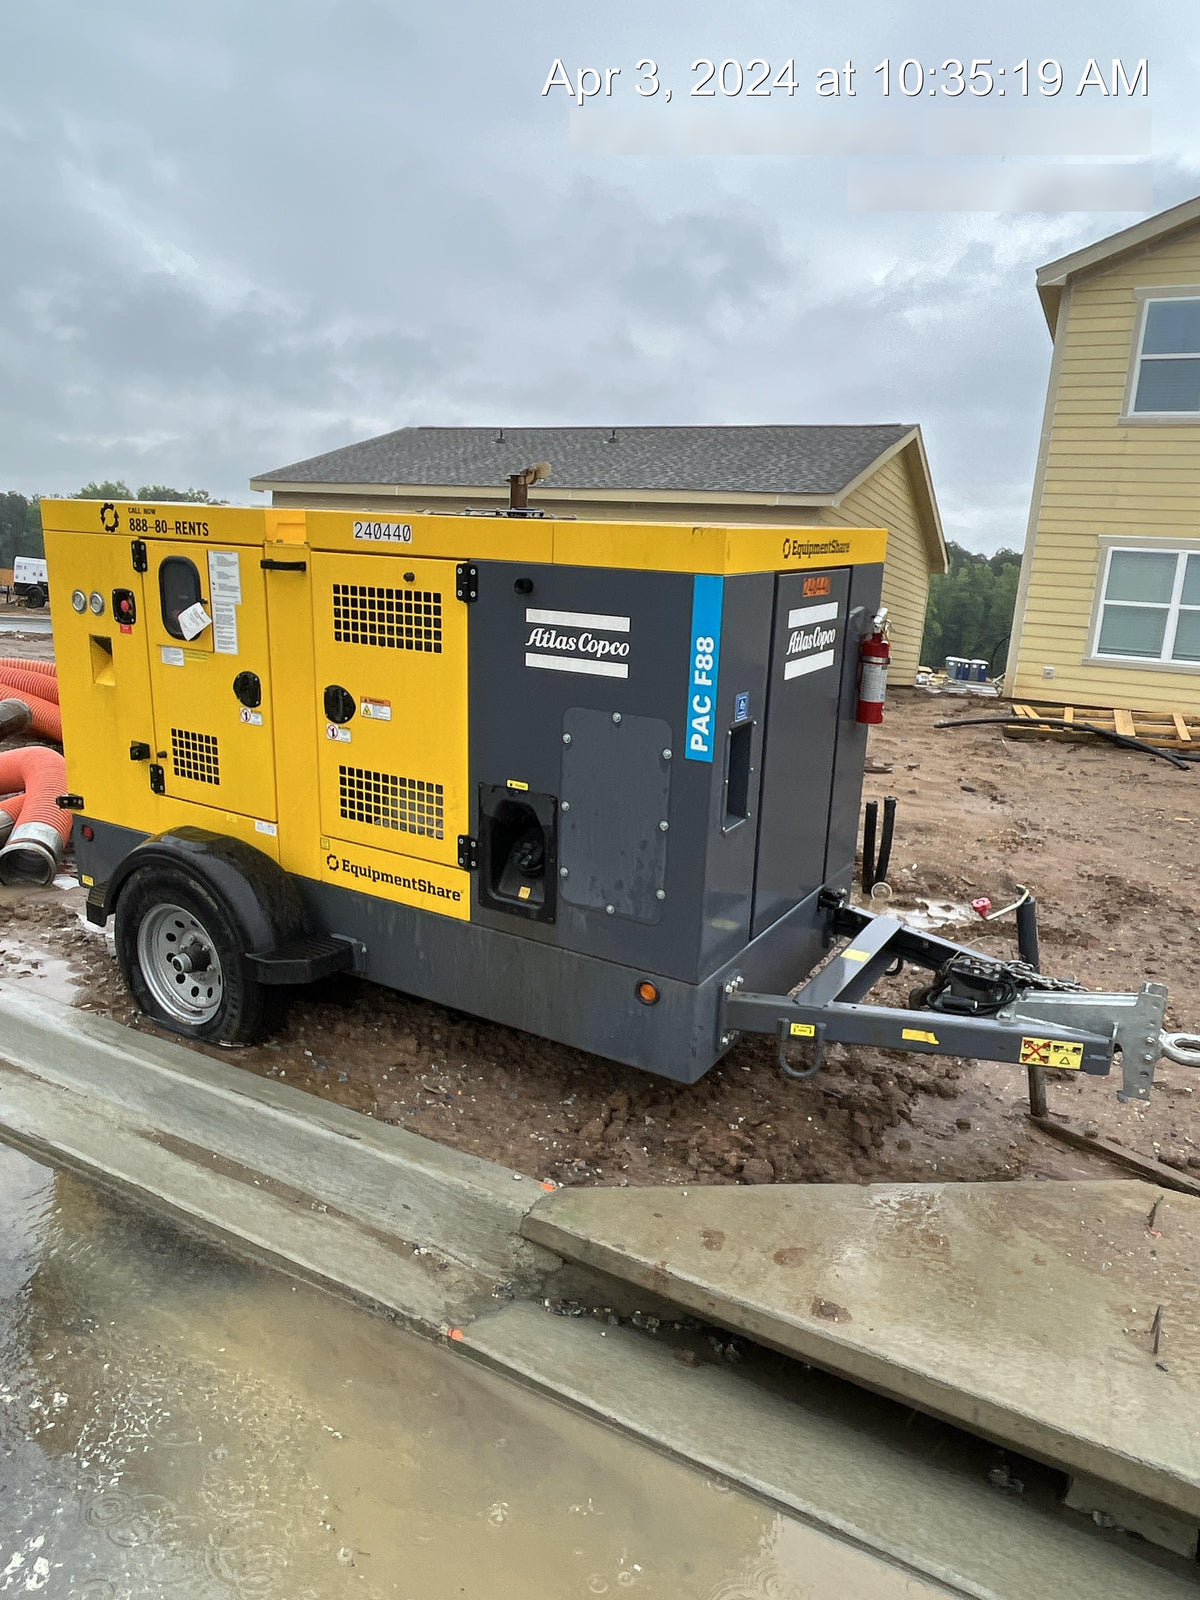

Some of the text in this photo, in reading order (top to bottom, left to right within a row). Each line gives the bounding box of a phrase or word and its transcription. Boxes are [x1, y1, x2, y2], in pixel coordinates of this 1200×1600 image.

[127, 507, 142, 515] CALL
[128, 517, 209, 537] 888-80-RENTS
[354, 521, 411, 542] 240440
[791, 539, 850, 559] EquipmentShare
[525, 627, 630, 657] Atlas Copco
[785, 626, 836, 655] Atlas Copco
[690, 636, 715, 752] PAC F88
[341, 858, 461, 902] EquipmentShare
